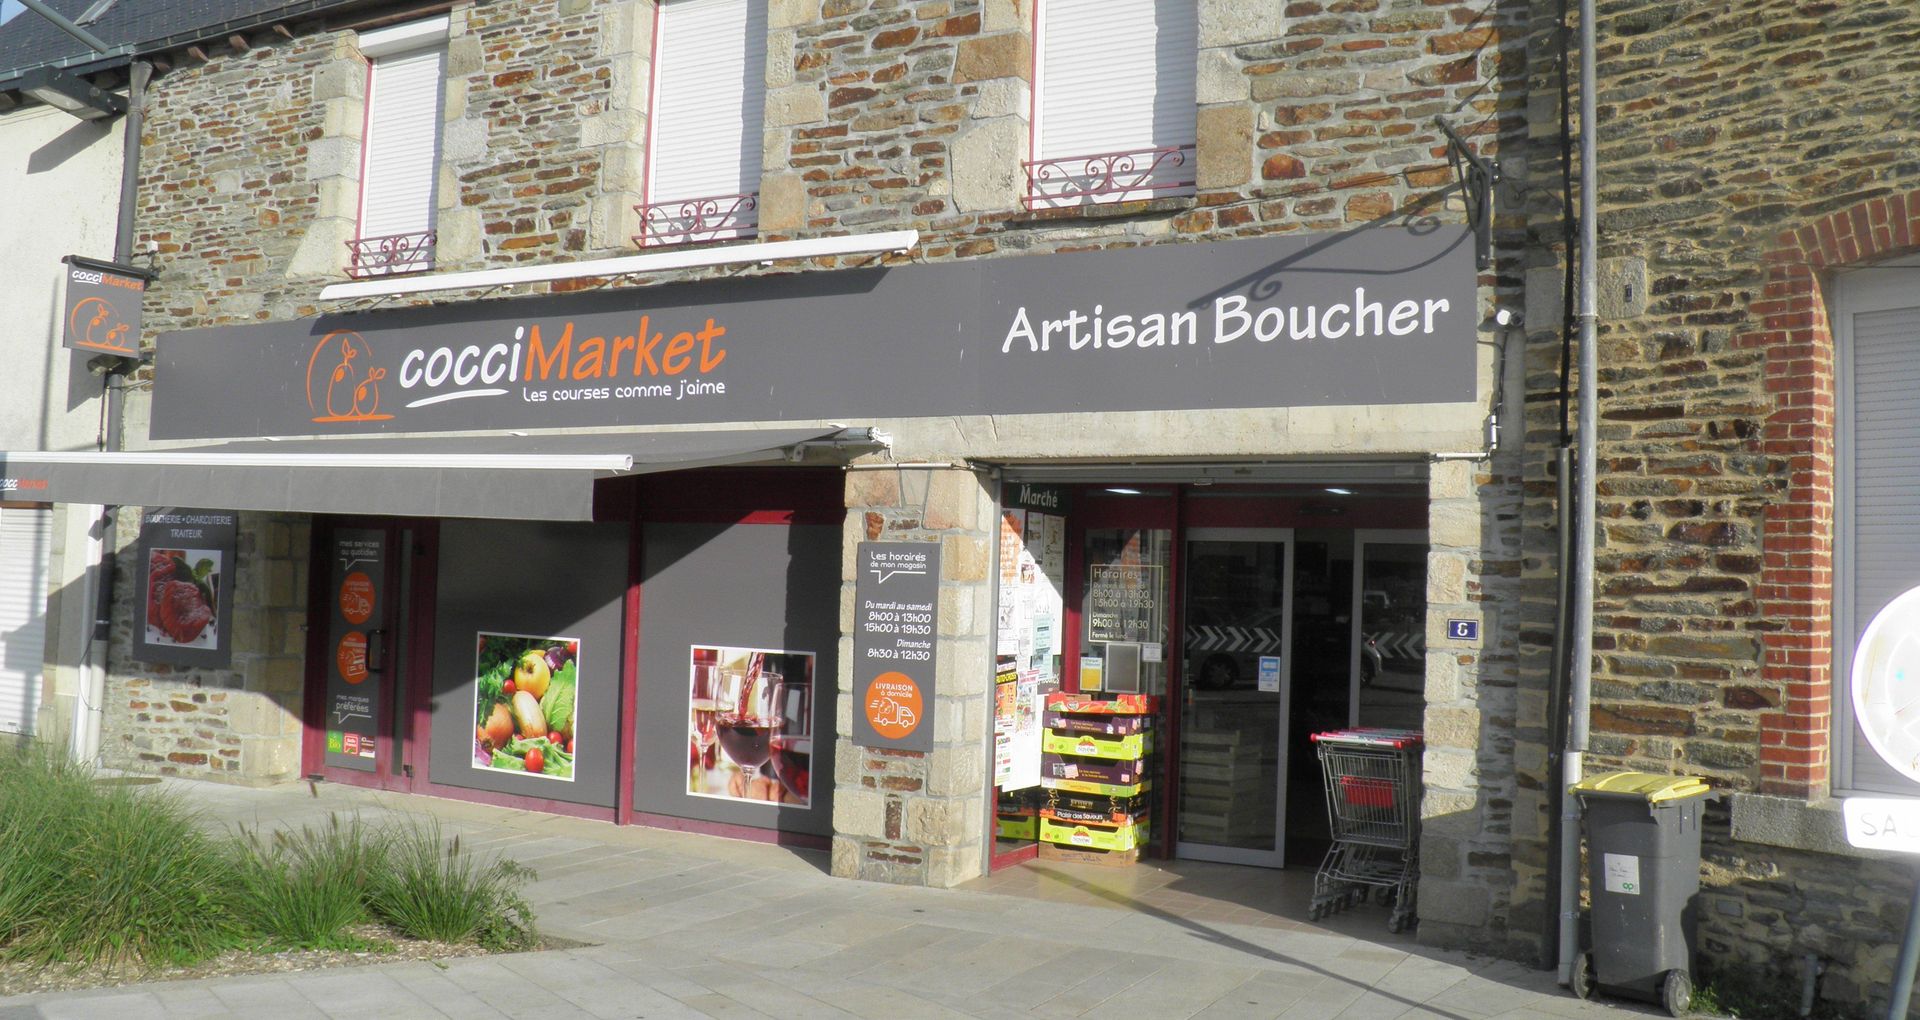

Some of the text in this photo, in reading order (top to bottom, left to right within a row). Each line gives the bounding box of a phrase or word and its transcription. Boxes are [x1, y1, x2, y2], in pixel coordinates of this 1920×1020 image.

[72, 270, 144, 290] cocciMarket
[1002, 287, 1450, 353] Artisan Boucher
[400, 315, 727, 389] cocciMarket
[553, 385, 610, 401] courses
[615, 384, 672, 398] comme
[676, 379, 726, 400] j'aime
[1019, 485, 1058, 508] Marché
[145, 514, 232, 525] BOUCHERIE CHARCUTERIE
[170, 529, 202, 538] TRAITEUR
[351, 549, 377, 558] quotidien
[889, 552, 926, 561] horaires
[897, 562, 926, 570] magasin
[1093, 590, 1113, 598] 8h00
[1124, 590, 1149, 599] 13h00
[865, 600, 875, 609] Du
[876, 601, 896, 610] mardi
[906, 603, 933, 611] samedi
[1094, 599, 1118, 607] 15h00
[1129, 600, 1154, 608] 19h30
[868, 611, 931, 623] 8h00 à 13h00
[864, 623, 931, 635] 15h00 à 19h30
[1092, 618, 1113, 628] 9h00
[1123, 620, 1149, 629] 12h30
[896, 639, 931, 649] Dimanche
[867, 648, 930, 661] 8h30 à 12h30
[875, 682, 913, 691] LIVRAISON
[336, 701, 369, 712] préférées
[1057, 811, 1072, 819] Plaisir
[1083, 812, 1103, 820] Saveurs
